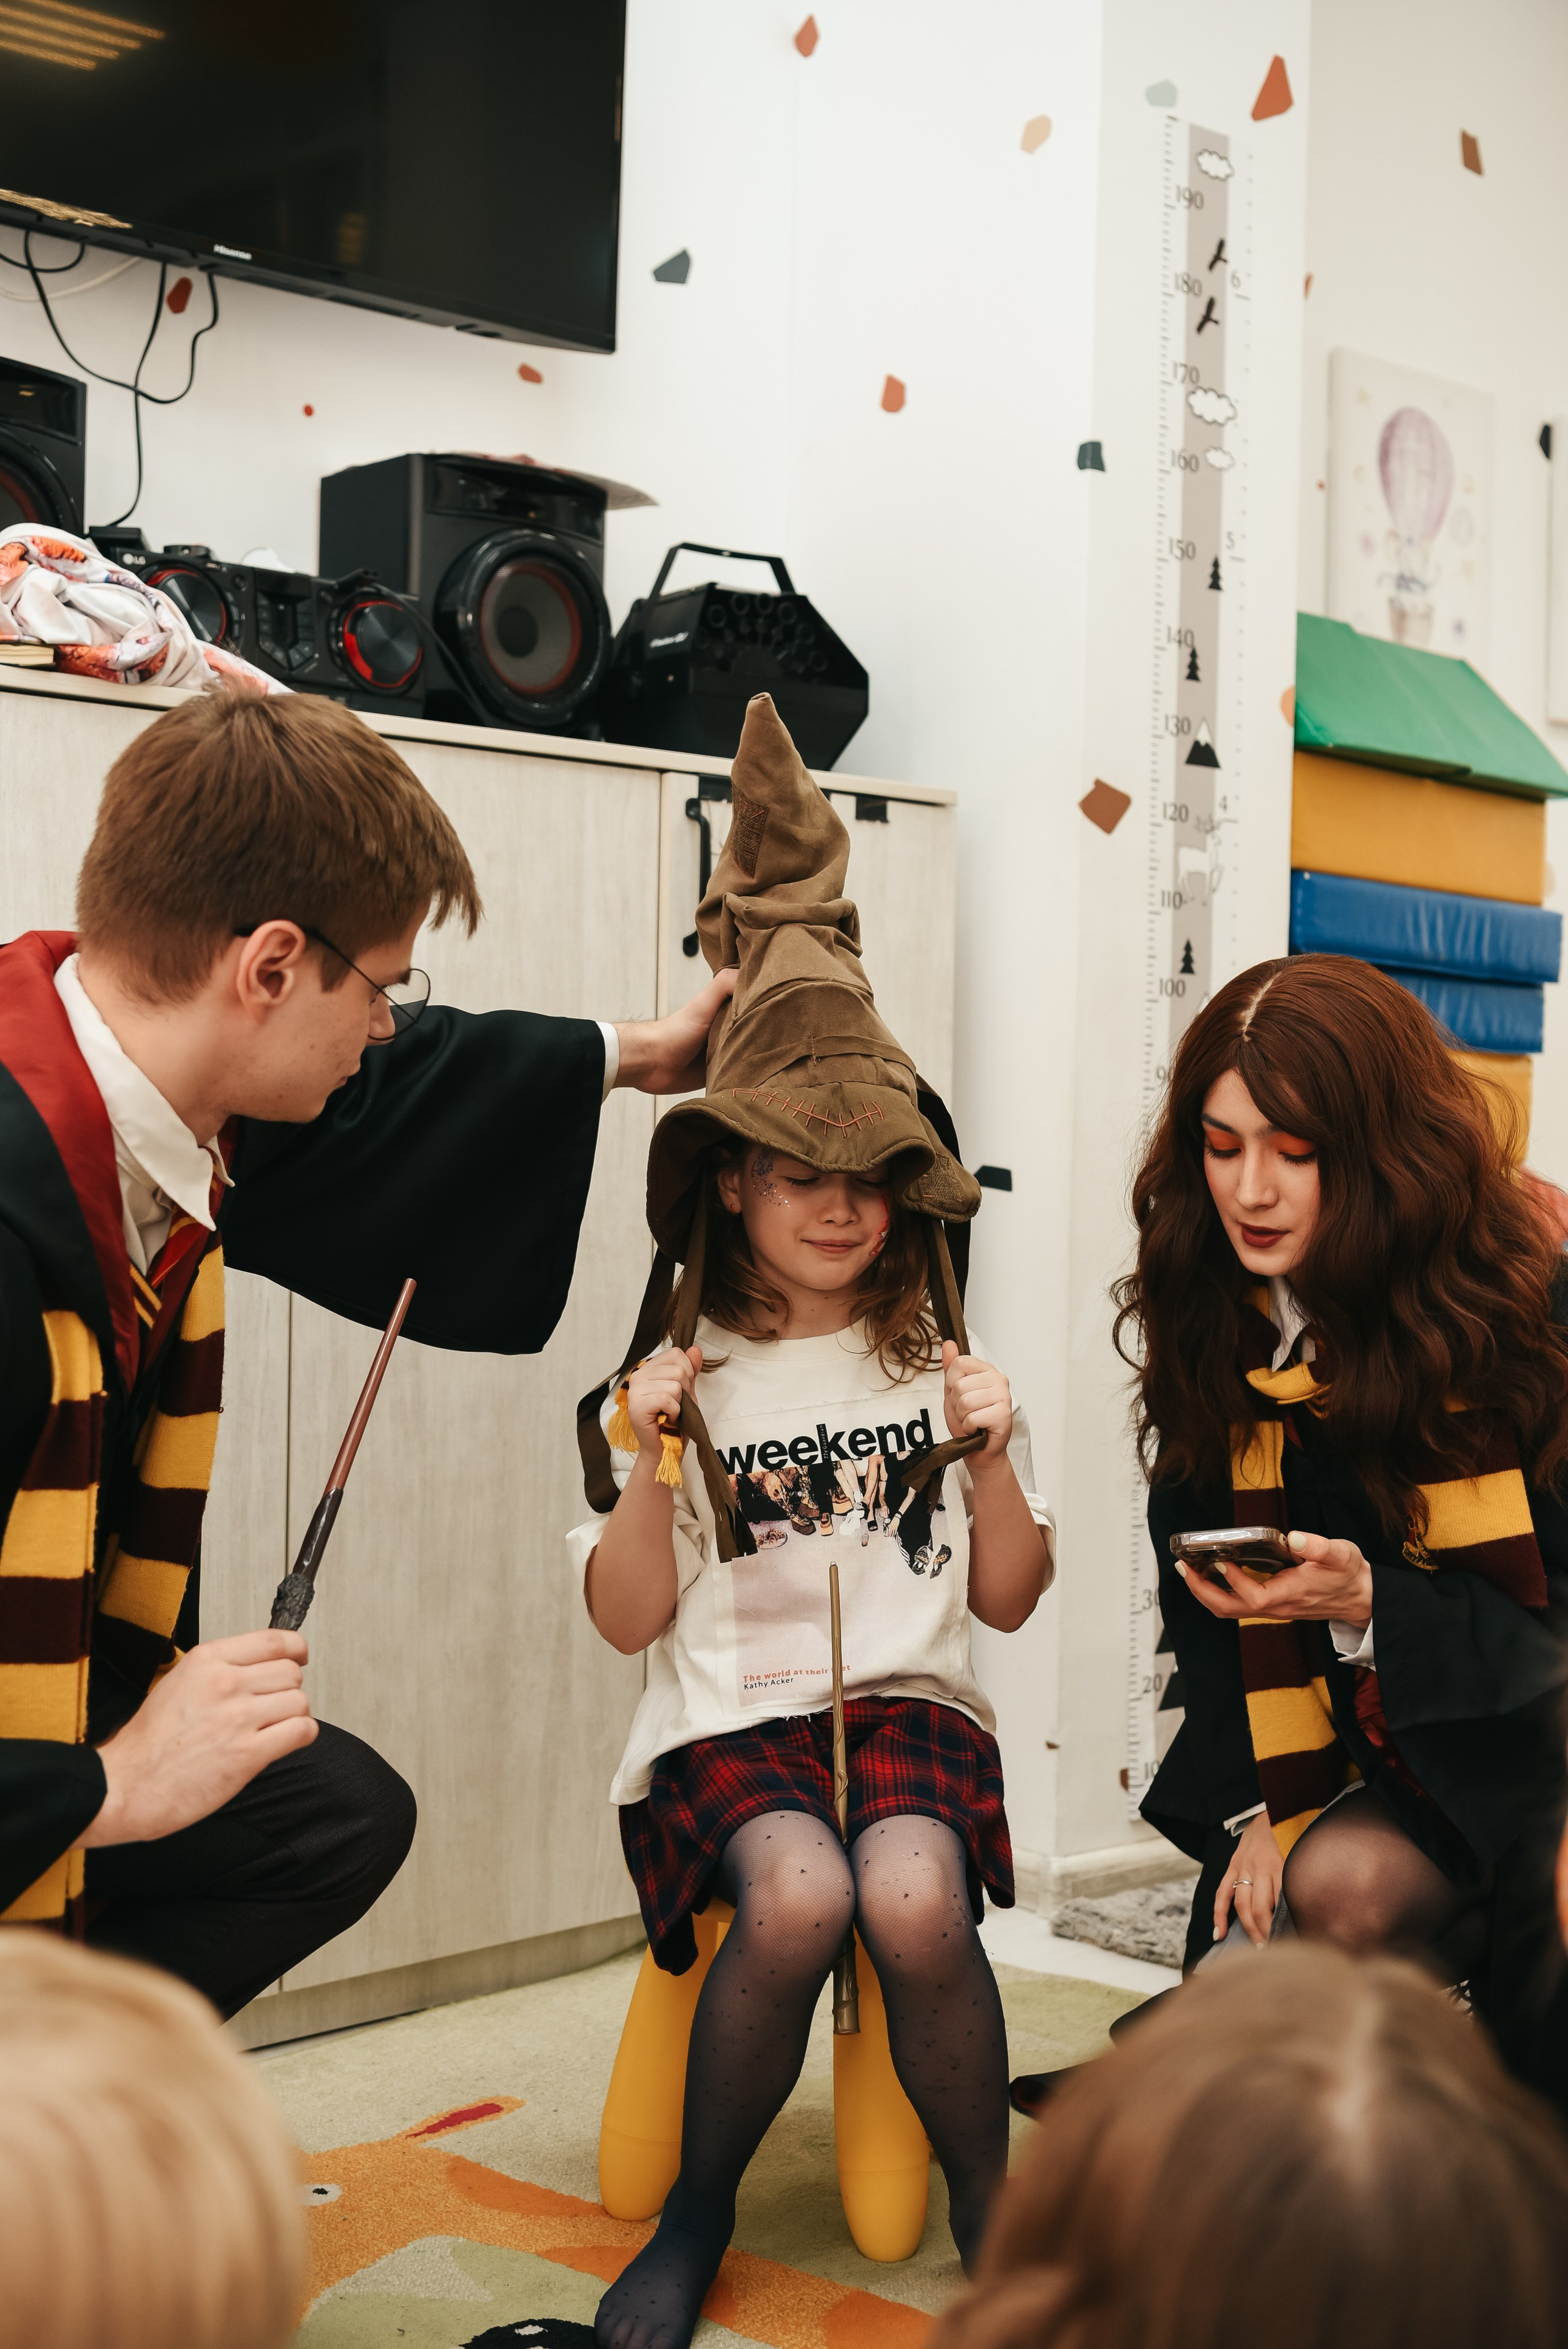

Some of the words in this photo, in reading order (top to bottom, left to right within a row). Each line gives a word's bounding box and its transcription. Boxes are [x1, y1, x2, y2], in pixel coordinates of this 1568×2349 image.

[1175, 184, 1204, 209] 190
[1174, 272, 1202, 296] 180
[1231, 270, 1240, 289] 6
[1172, 360, 1200, 385] 170
[1170, 449, 1199, 472] 160
[1168, 537, 1196, 560] 150
[1226, 531, 1235, 550] 5
[1166, 626, 1194, 647] 140
[1164, 714, 1191, 736] 130
[1163, 802, 1188, 823] 120
[1219, 796, 1227, 813] 4
[1161, 891, 1183, 910] 110
[1158, 979, 1186, 998] 100
[715, 1408, 934, 1476] weekend
[743, 1674, 761, 1683] The
[764, 1669, 791, 1680] world
[744, 1680, 768, 1690] Kathy
[771, 1678, 794, 1686] Acker
[1142, 1673, 1163, 1694] 20
